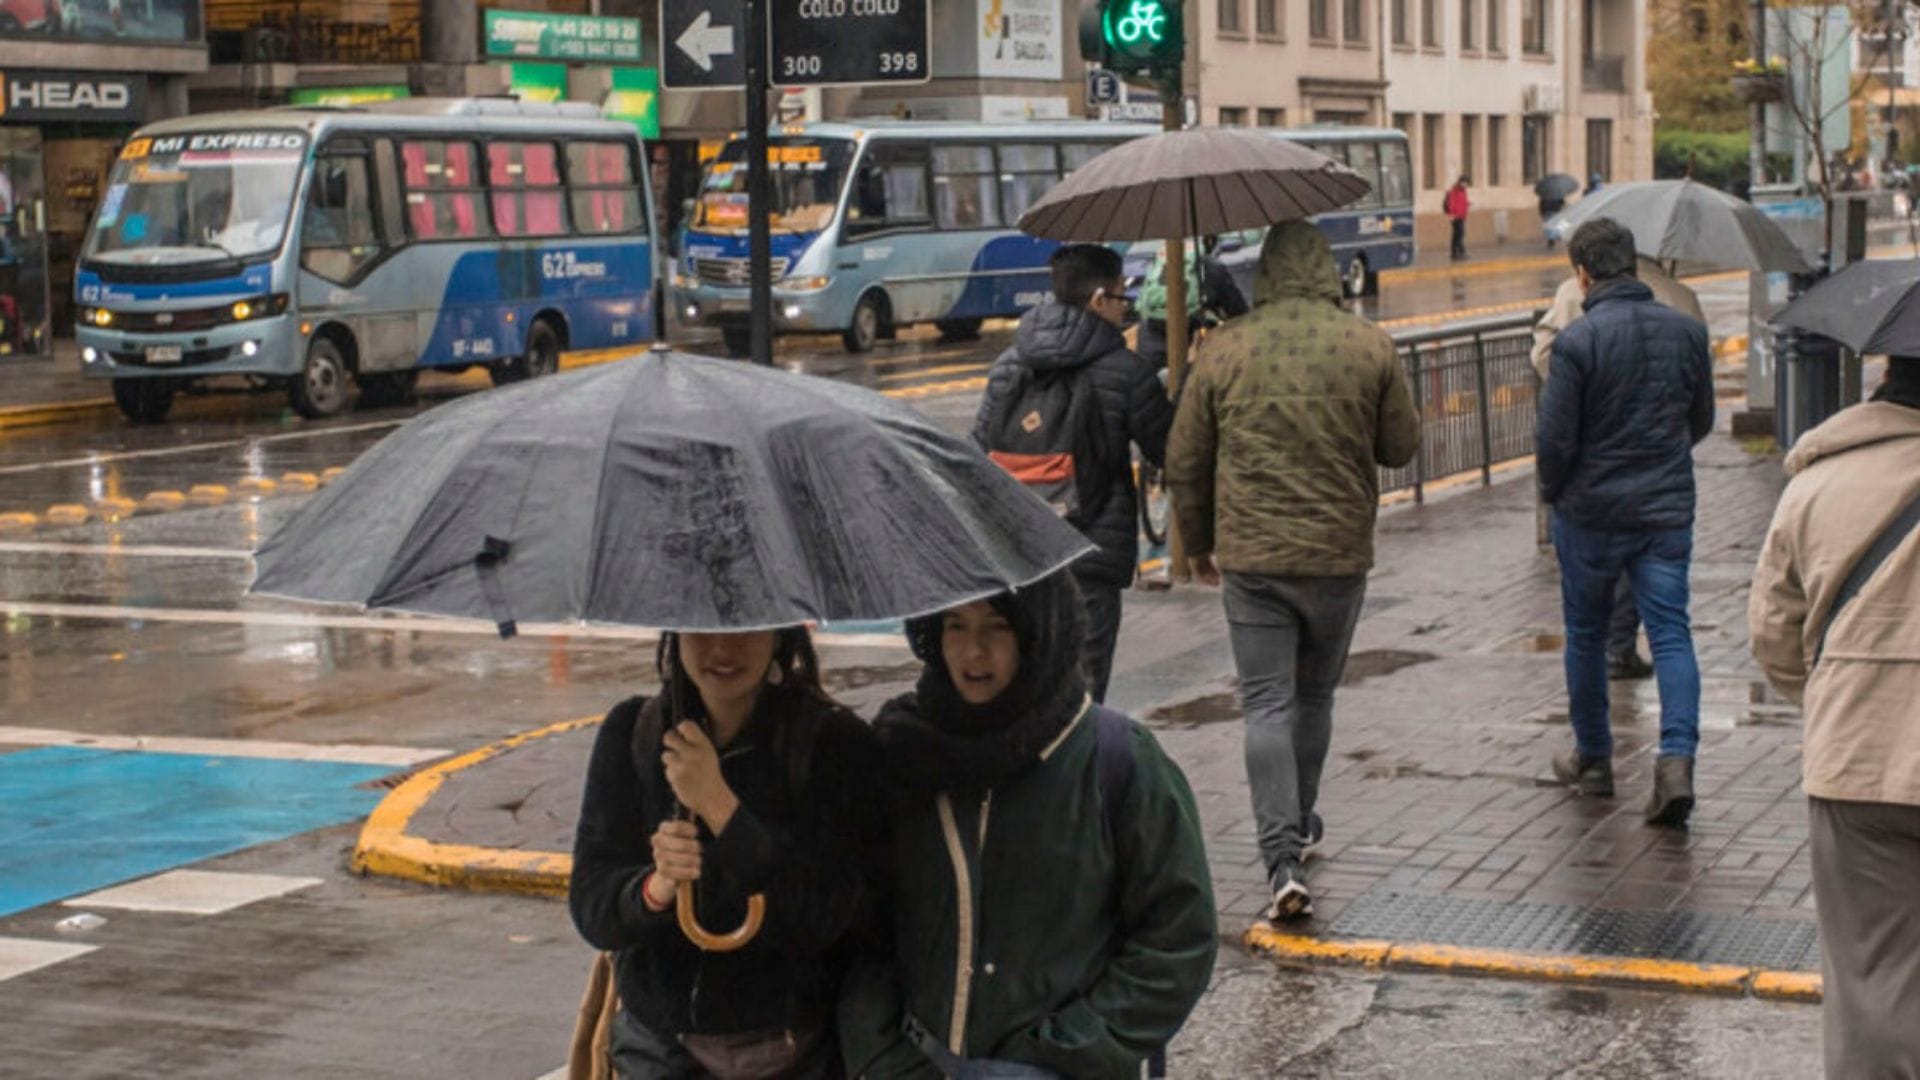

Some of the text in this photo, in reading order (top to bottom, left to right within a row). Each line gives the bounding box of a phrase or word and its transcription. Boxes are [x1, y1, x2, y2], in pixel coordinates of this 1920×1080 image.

[800, 0, 900, 18] COLO COLO
[783, 56, 820, 76] 300
[880, 52, 918, 73] 398
[10, 81, 129, 109] HEAD
[1097, 76, 1111, 98] E
[152, 136, 185, 153] MI
[190, 133, 302, 150] EXPRESO
[542, 253, 565, 279] 62
